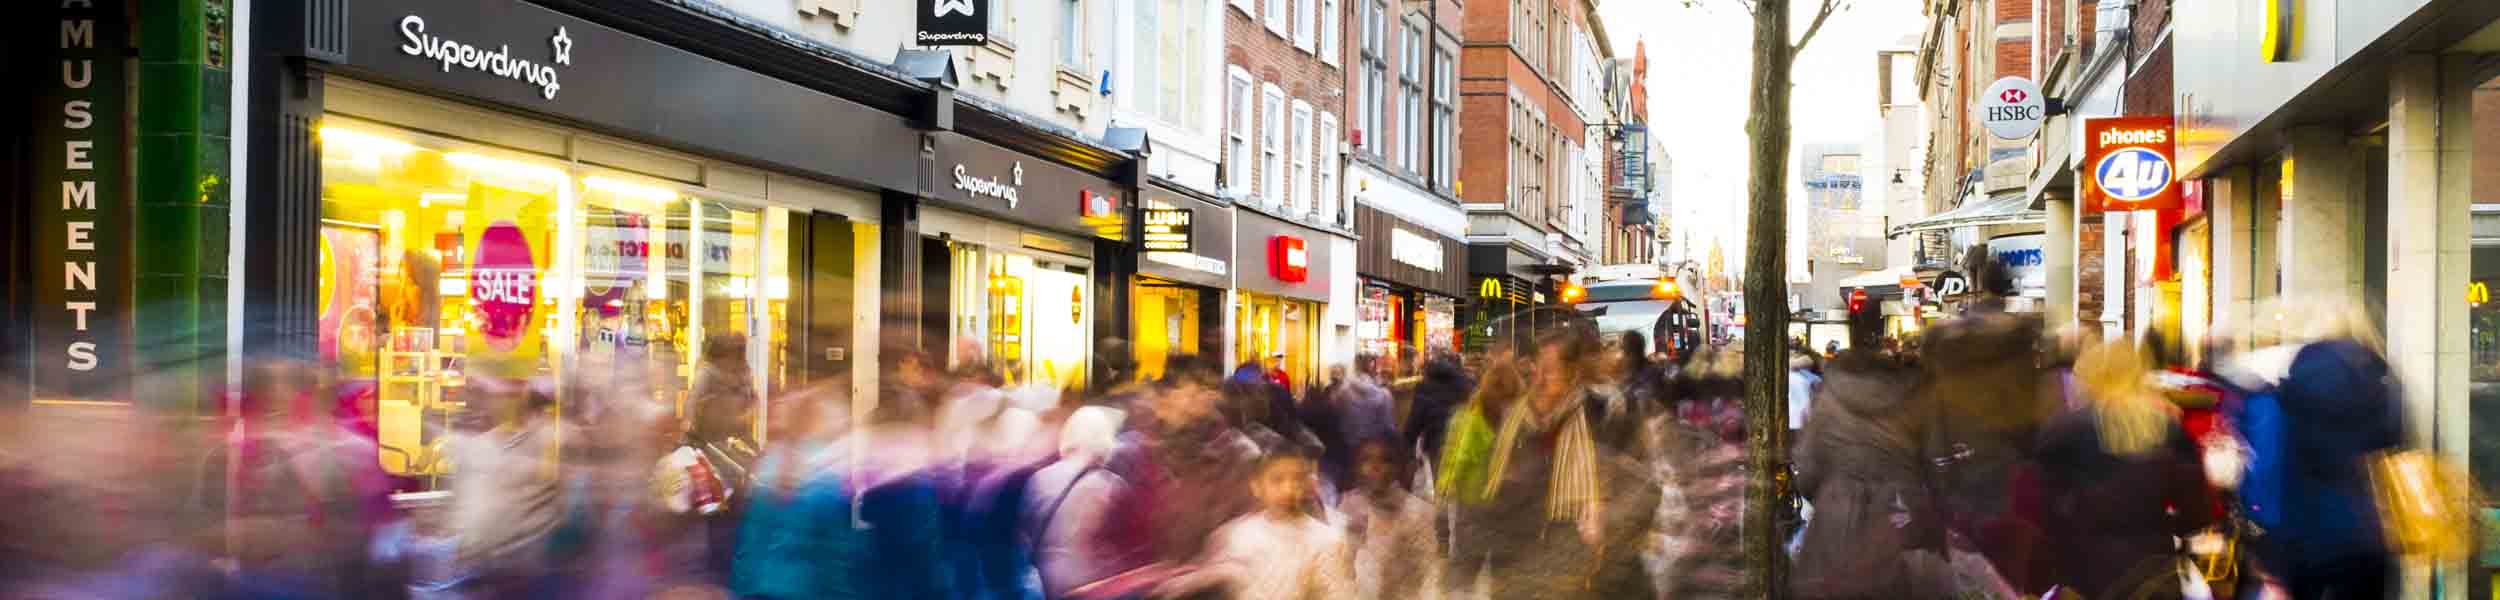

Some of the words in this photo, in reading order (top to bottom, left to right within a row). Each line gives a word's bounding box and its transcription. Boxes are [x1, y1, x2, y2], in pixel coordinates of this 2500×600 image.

[918, 31, 984, 42] Superdrug
[401, 15, 560, 100] Superdrug
[1988, 105, 2040, 121] HSBC
[2100, 128, 2166, 148] phones
[61, 0, 98, 370] MUSEMENTS
[955, 164, 1018, 209] Superdrug
[477, 270, 530, 304] SALE
[1937, 277, 1965, 298] JD
